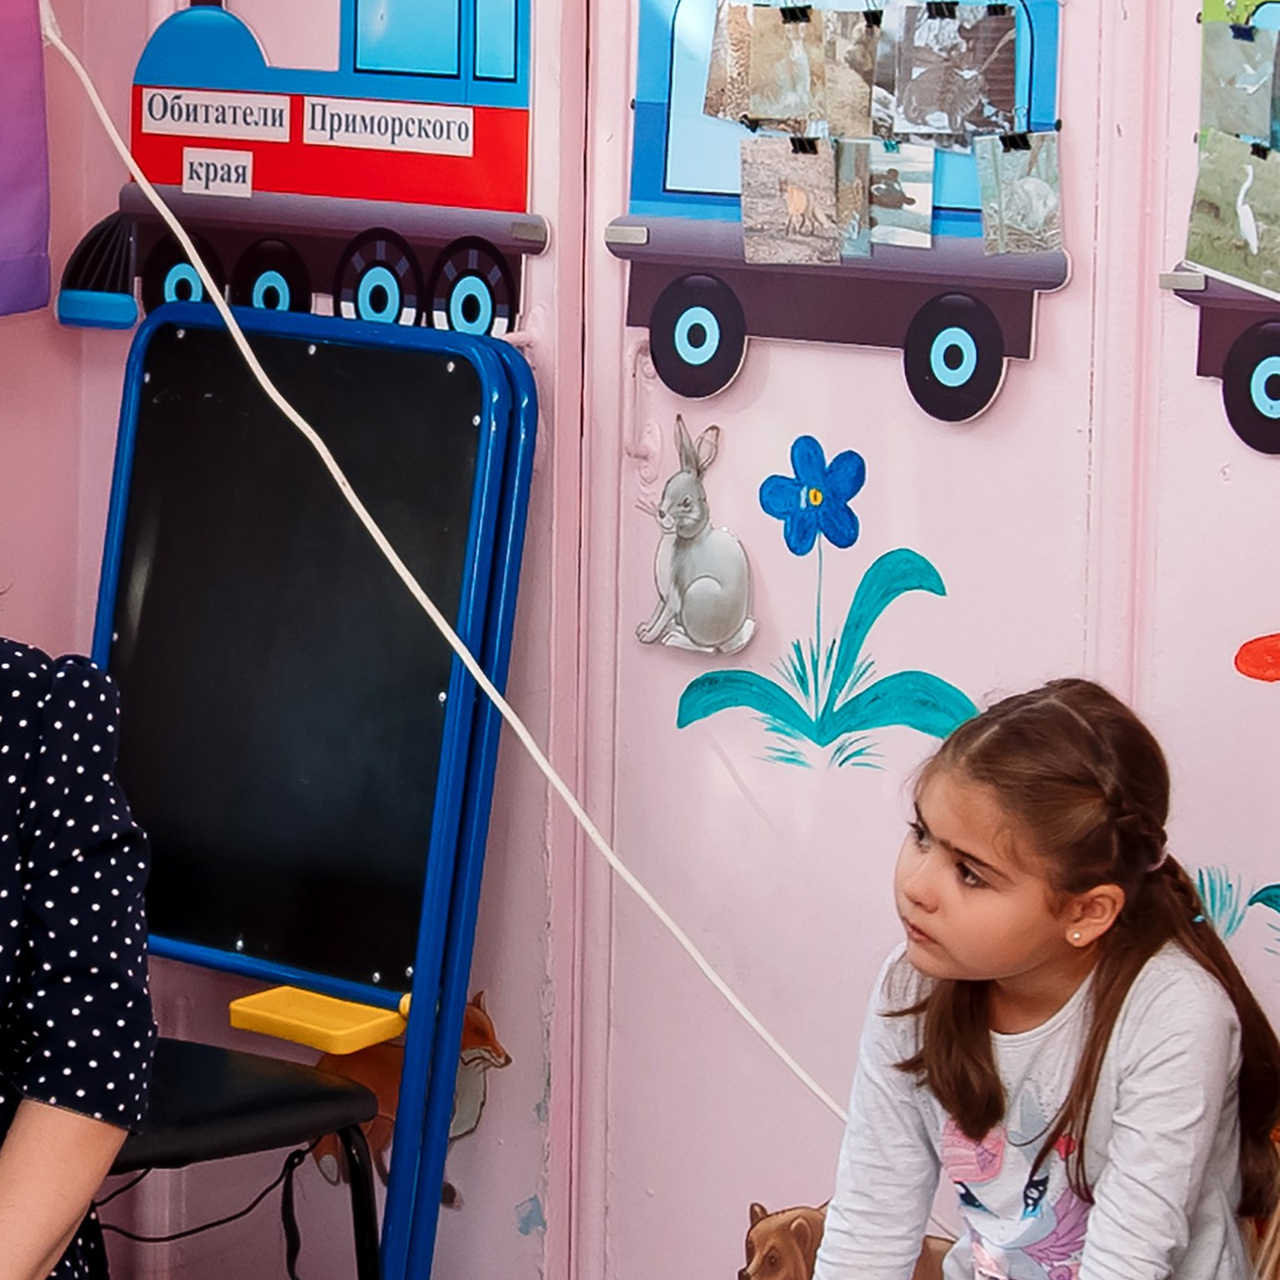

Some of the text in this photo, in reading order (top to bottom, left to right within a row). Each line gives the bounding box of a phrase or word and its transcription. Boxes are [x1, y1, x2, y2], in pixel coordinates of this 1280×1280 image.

[147, 92, 470, 145] Обитатели Приморского
[188, 160, 248, 191] края
